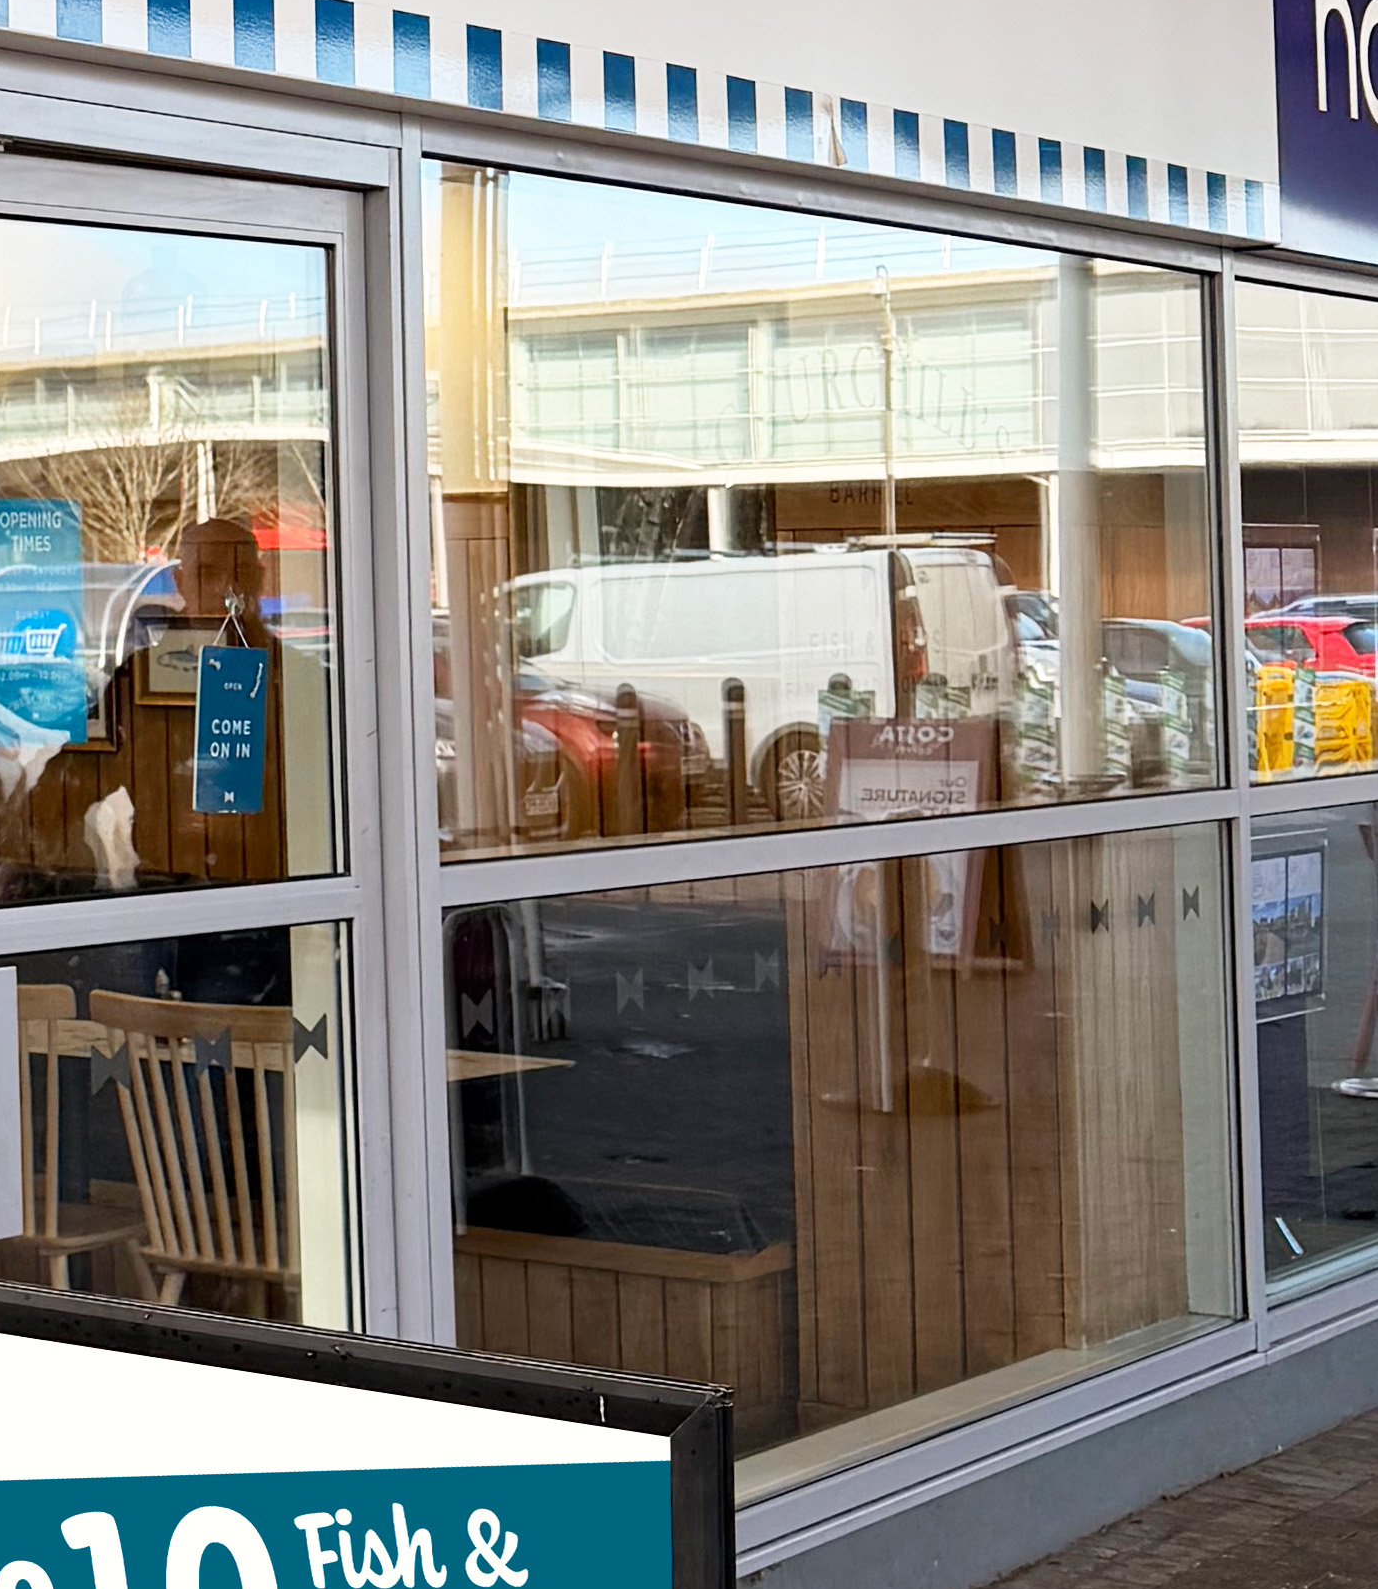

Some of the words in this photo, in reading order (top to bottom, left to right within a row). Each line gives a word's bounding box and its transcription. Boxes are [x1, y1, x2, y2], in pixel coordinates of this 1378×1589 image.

[11, 534, 52, 553] TIMES
[223, 682, 243, 691] OPEN
[211, 718, 252, 736] COME
[209, 741, 231, 759] ON
[235, 742, 251, 759] IN
[294, 1502, 447, 1589] Fish
[464, 1507, 530, 1588] &
